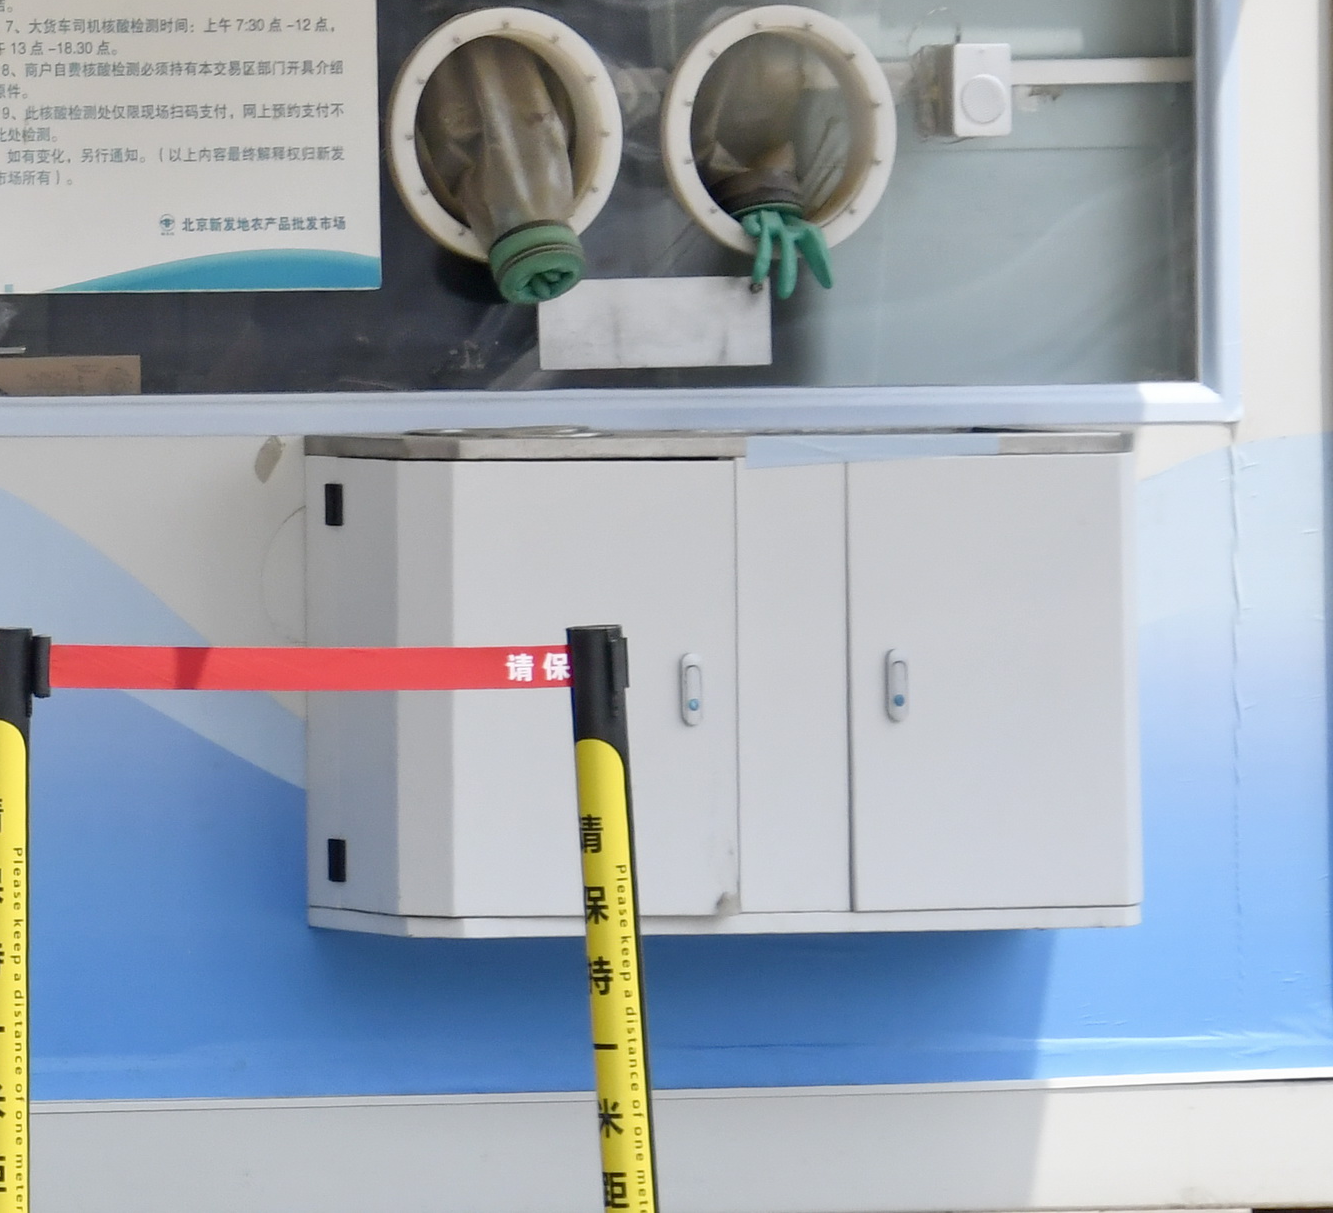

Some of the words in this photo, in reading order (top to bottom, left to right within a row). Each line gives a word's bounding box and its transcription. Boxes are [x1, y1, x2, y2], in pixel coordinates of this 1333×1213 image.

[182, 215, 346, 232] 北京新发地农产品批发市场
[506, 653, 571, 682] 请保
[12, 847, 24, 911] Please
[615, 864, 628, 928] Please
[11, 918, 23, 965] keep
[620, 933, 632, 981] keep
[14, 989, 24, 1075] distance
[626, 1005, 639, 1092] distance
[14, 1082, 23, 1104] of
[632, 1099, 644, 1119] of
[14, 1109, 23, 1145] one
[634, 1126, 644, 1161] one
